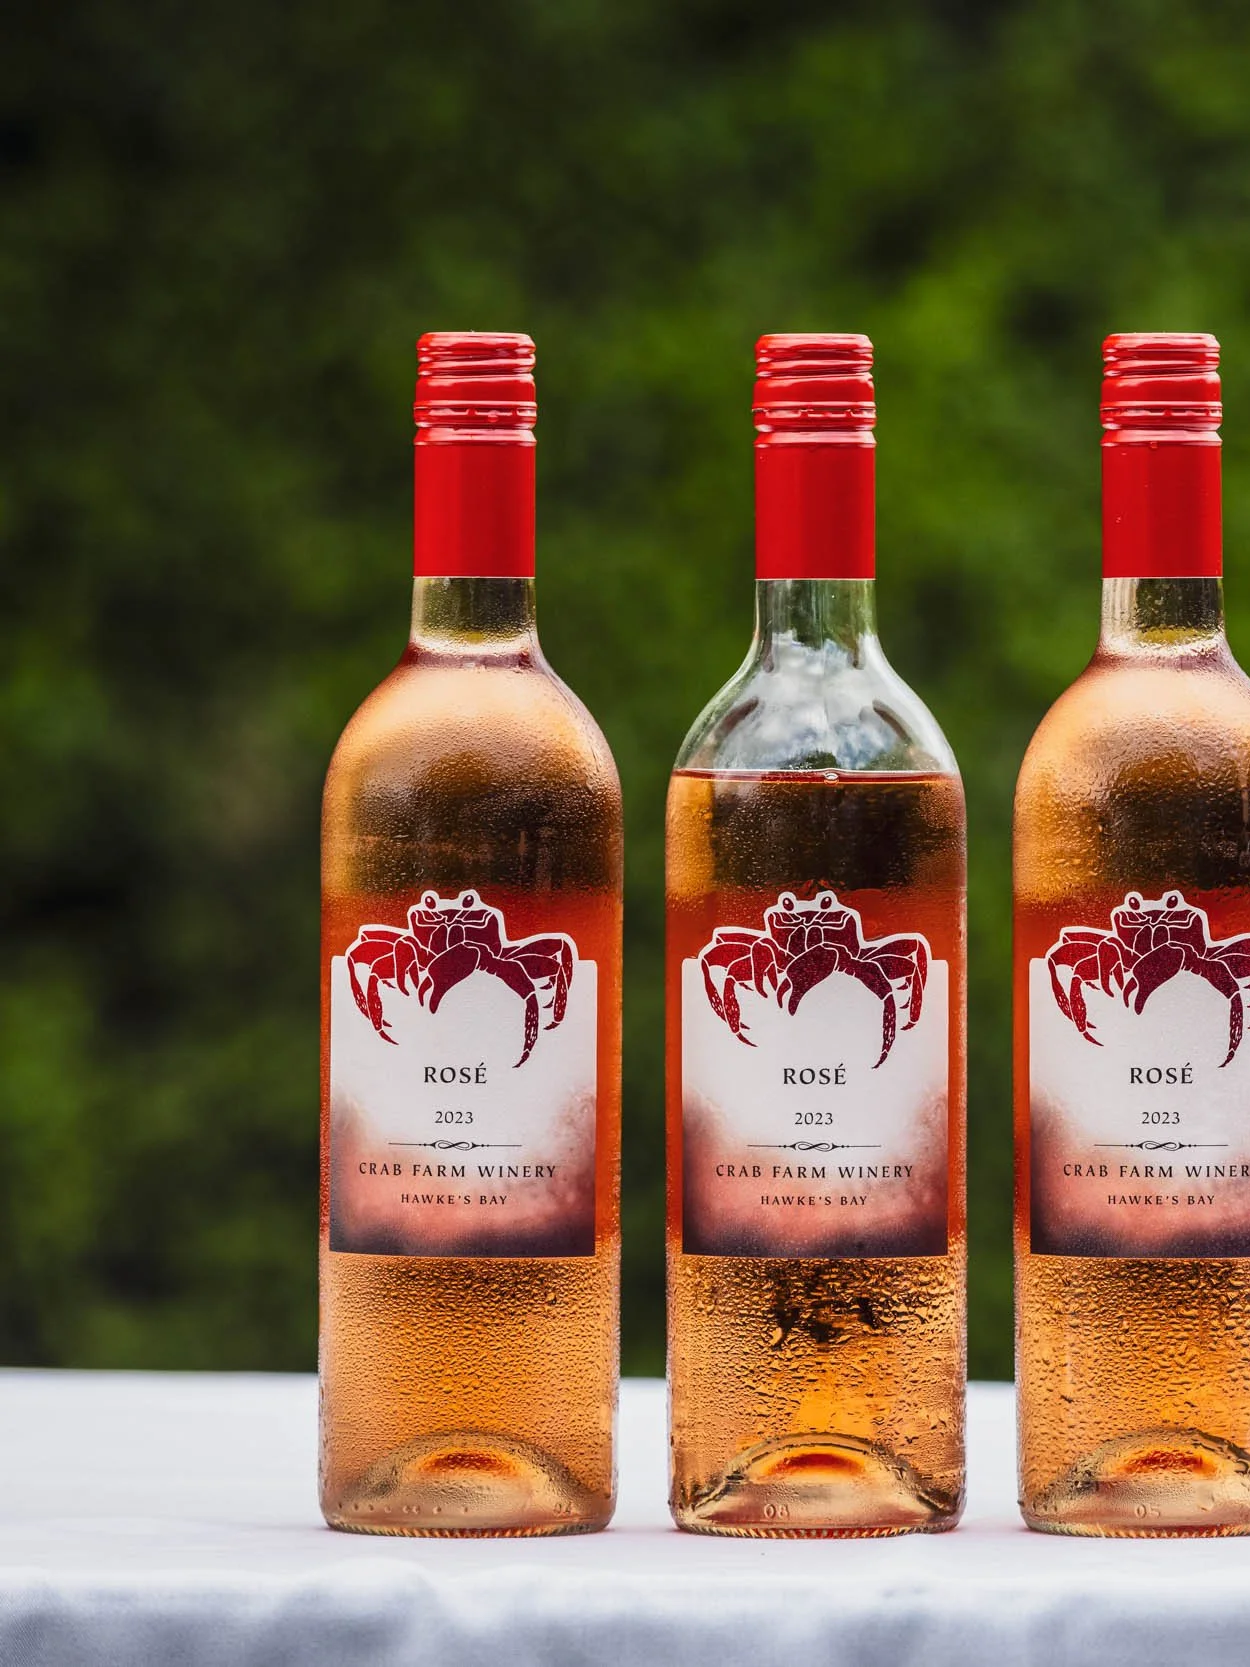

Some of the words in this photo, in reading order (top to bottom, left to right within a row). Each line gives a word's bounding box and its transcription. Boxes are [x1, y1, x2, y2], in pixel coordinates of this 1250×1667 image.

[423, 1061, 488, 1085] ROSÉ
[783, 1062, 847, 1086] ROSÉ
[1129, 1061, 1194, 1085] ROSÉ
[434, 1110, 474, 1125] 2023
[794, 1112, 834, 1126] 2023
[1141, 1111, 1181, 1125] 2023
[358, 1162, 402, 1177] CRAB
[412, 1164, 466, 1178] FARM
[477, 1165, 556, 1179] WINERY
[715, 1164, 762, 1178] CRAB
[772, 1165, 826, 1180] FARM
[837, 1165, 913, 1179] WINERY
[1063, 1163, 1109, 1178] CRAB
[1119, 1165, 1173, 1179] FARM
[400, 1193, 472, 1205] HAWKE'S
[479, 1194, 508, 1206] BAY
[760, 1195, 832, 1206] HAWKE'S
[840, 1195, 867, 1206] BAY
[1107, 1194, 1179, 1206] HAWKE'S
[1187, 1194, 1215, 1206] BAY
